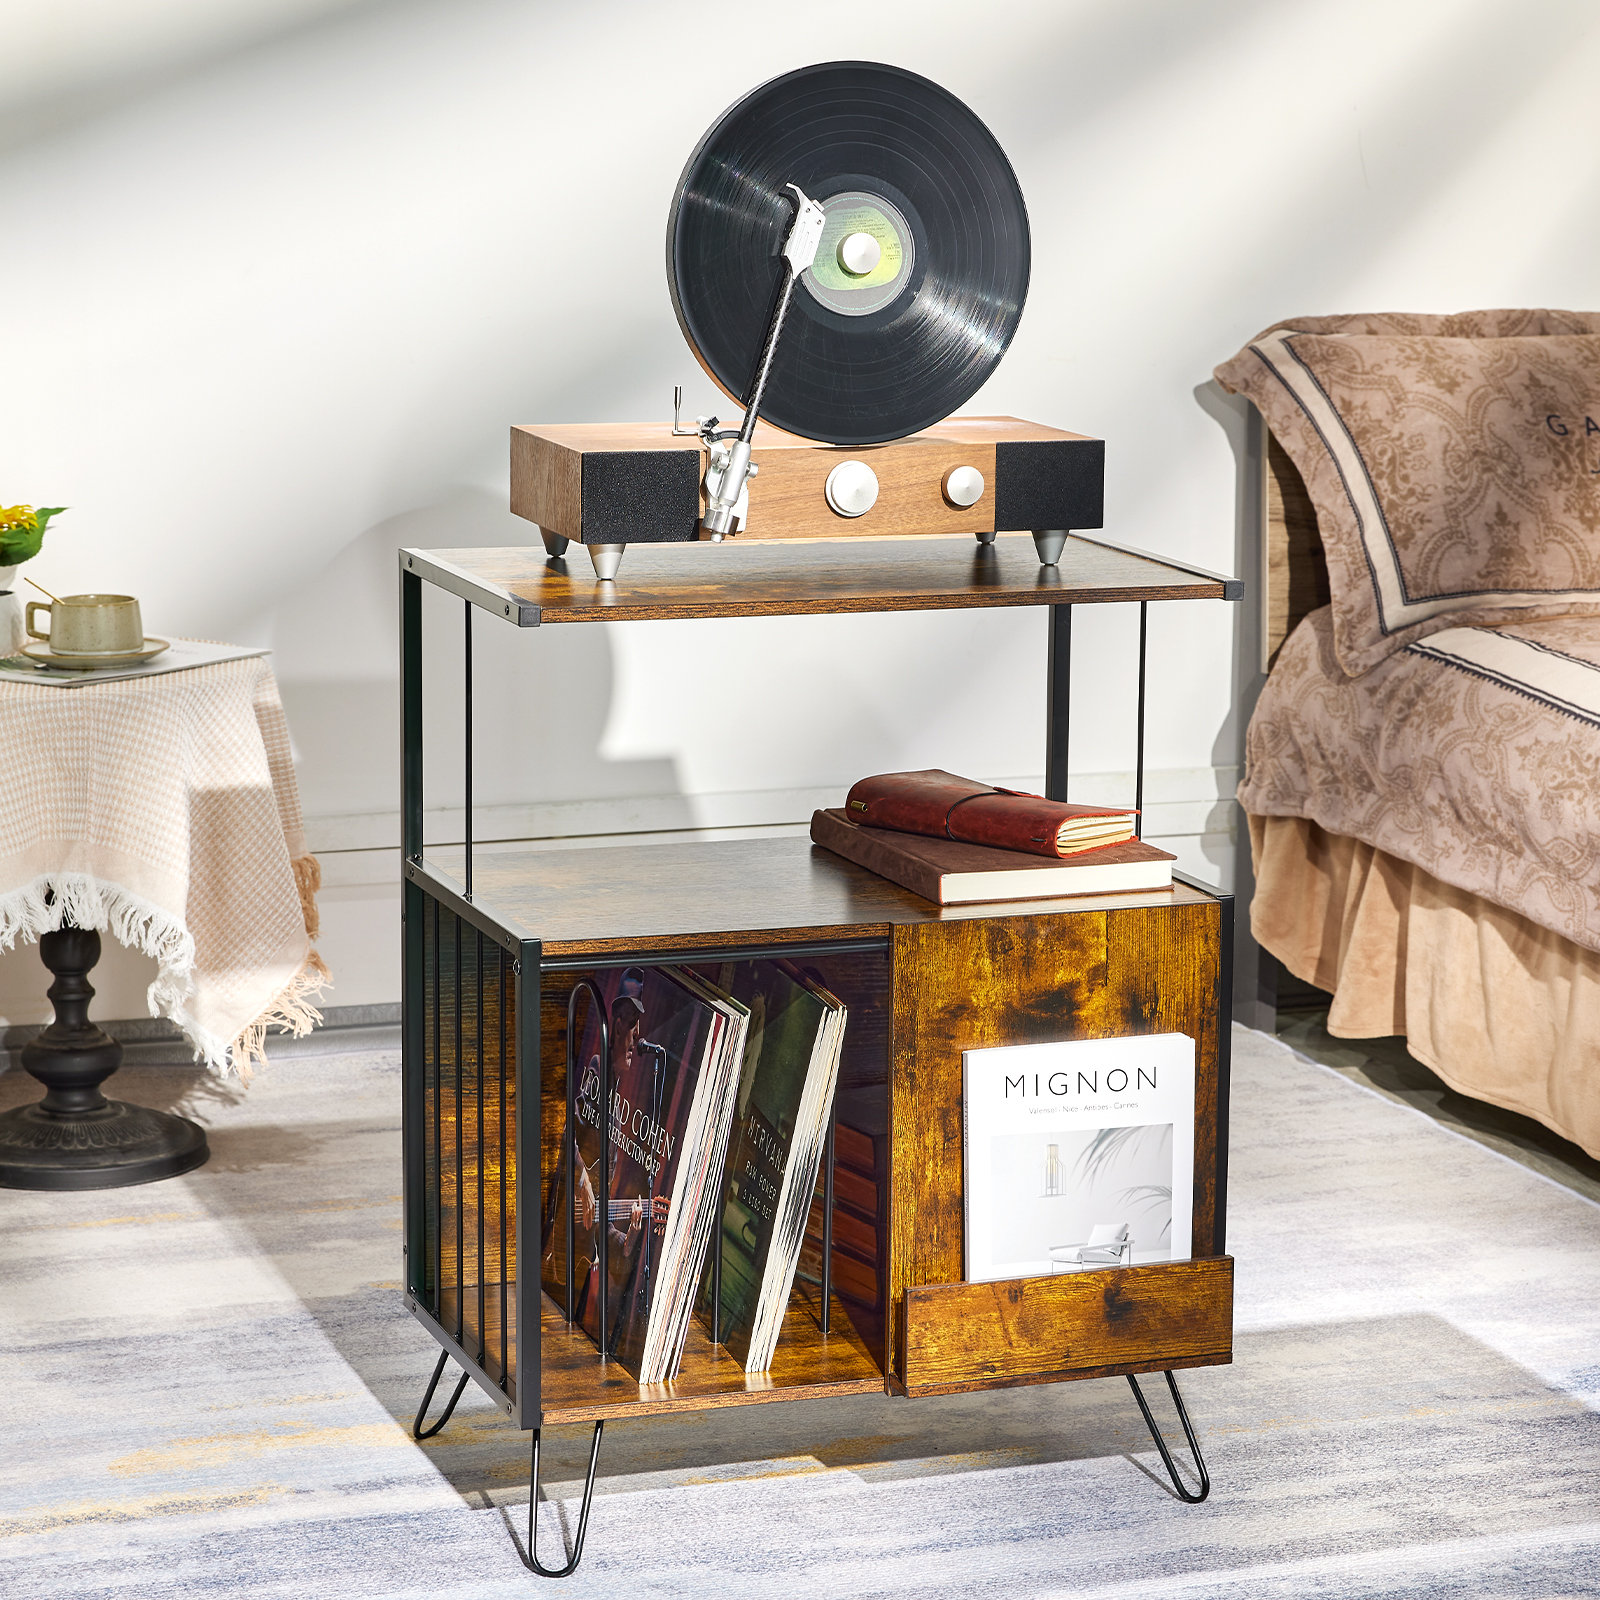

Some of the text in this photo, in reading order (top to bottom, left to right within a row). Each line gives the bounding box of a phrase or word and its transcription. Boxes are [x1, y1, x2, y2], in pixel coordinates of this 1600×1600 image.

[1005, 1066, 1156, 1098] MIGNON
[581, 1103, 596, 1126] LIVE
[1062, 1105, 1078, 1113] Nice
[632, 1109, 675, 1161] COHEN
[748, 1115, 787, 1183] NIRVANA
